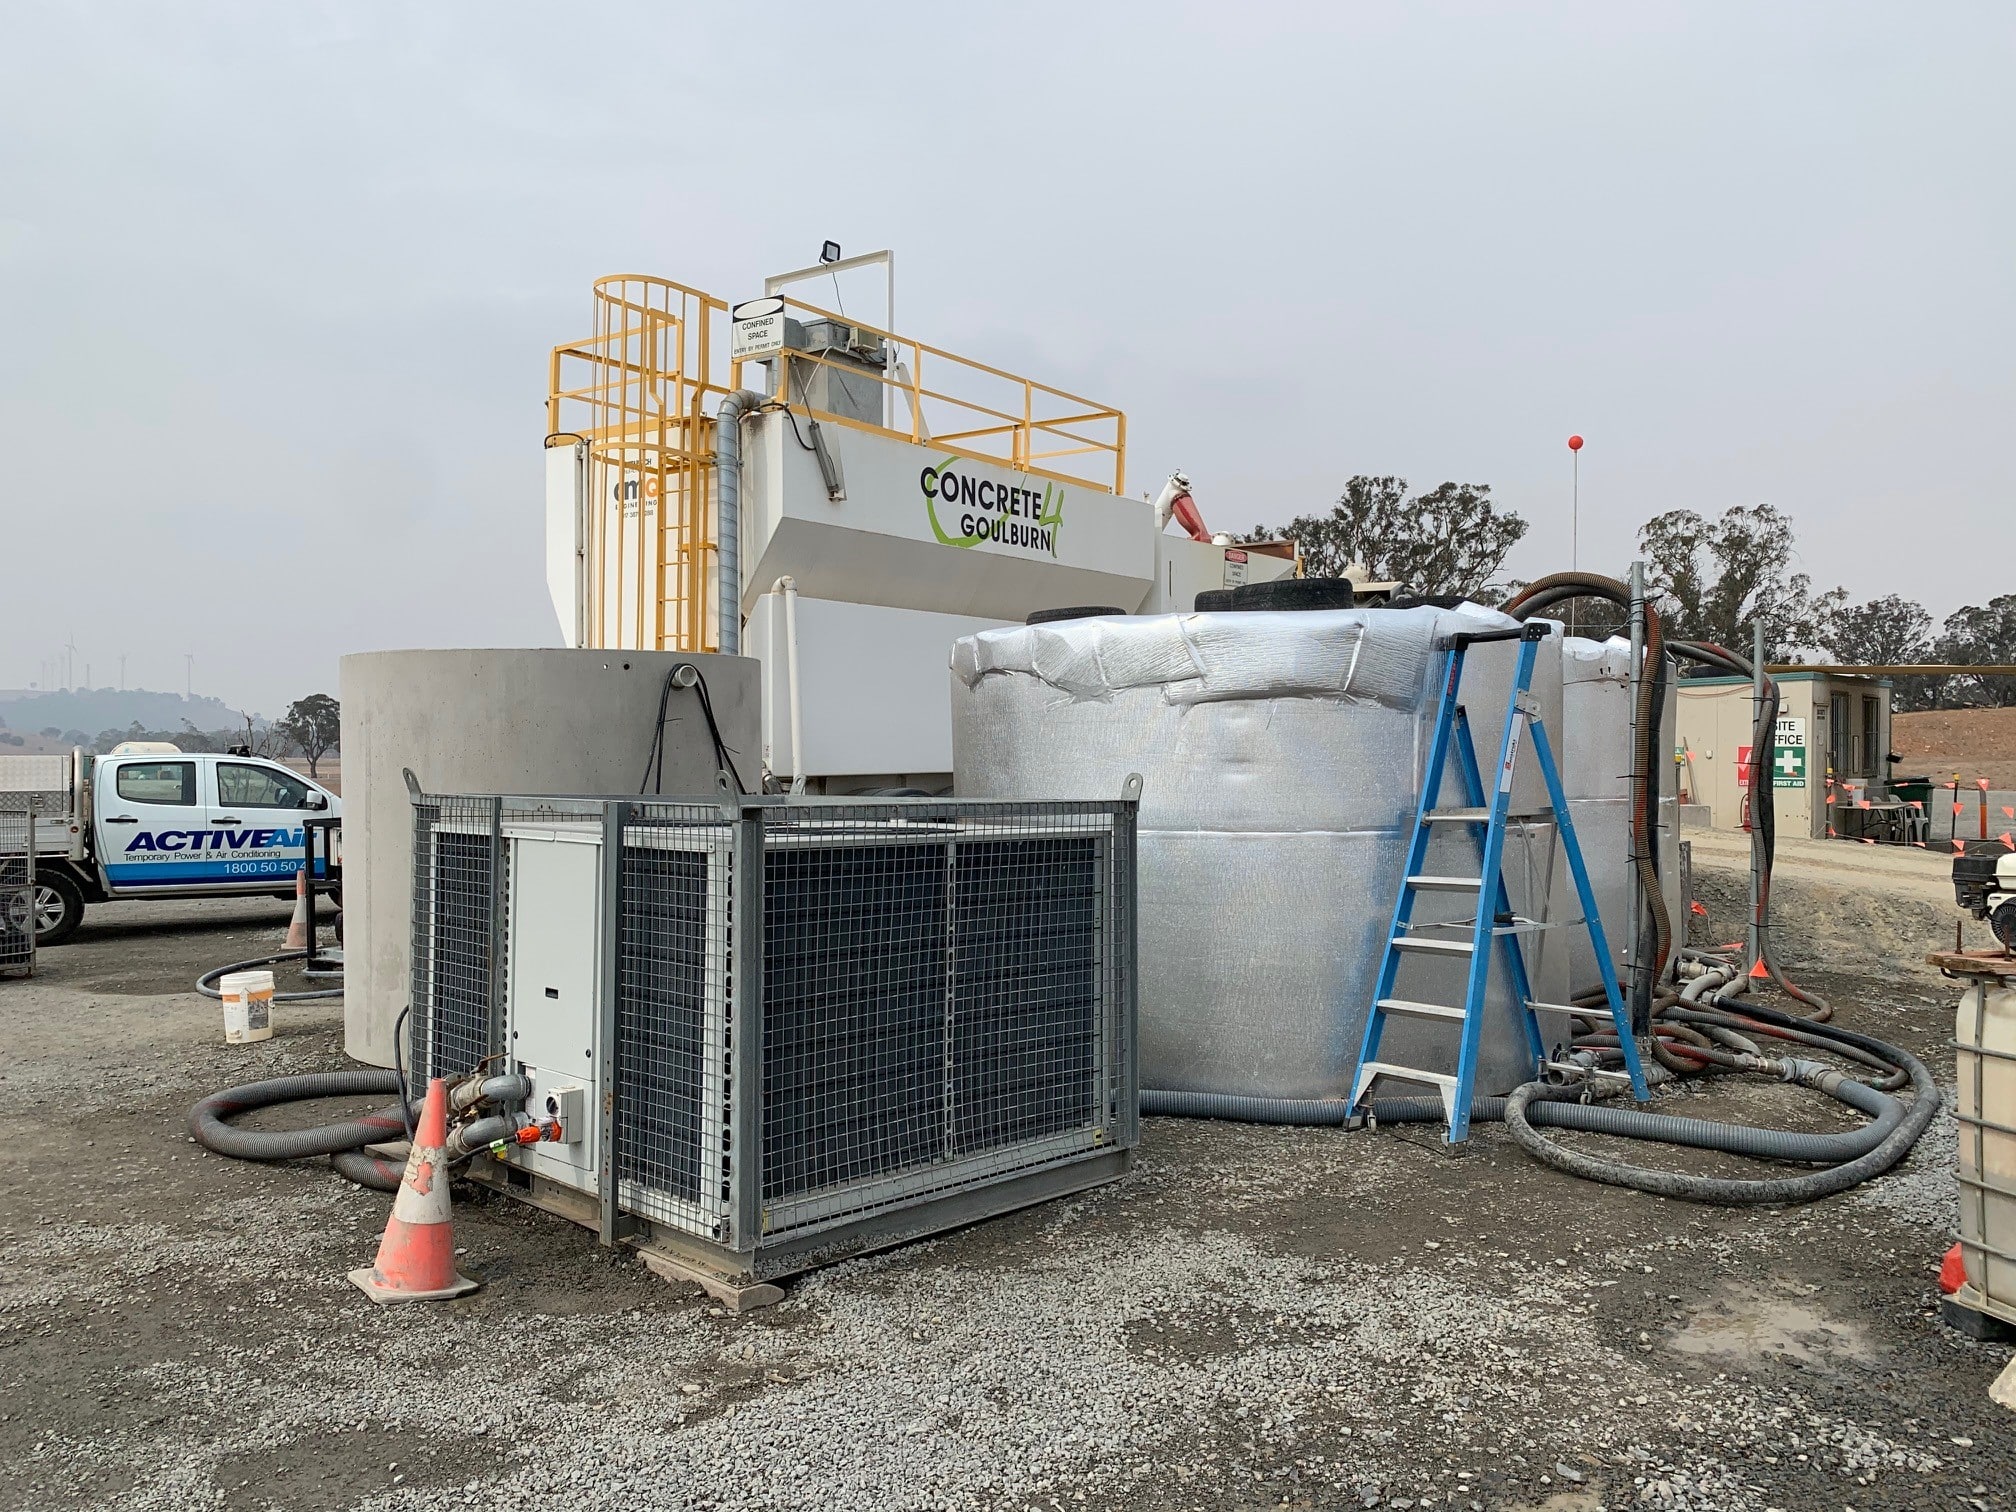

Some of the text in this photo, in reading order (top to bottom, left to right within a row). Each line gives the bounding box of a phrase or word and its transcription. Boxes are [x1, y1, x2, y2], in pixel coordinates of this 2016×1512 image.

[742, 318, 774, 330] CONFINED
[748, 330, 768, 340] SPACE
[755, 342, 770, 350] PERMIT
[920, 466, 1064, 558] CONCRETE 4
[961, 513, 1051, 551] GOULBURN
[1774, 734, 1803, 745] FICE
[123, 849, 281, 862] Temporary Power & Air Conditioning
[224, 862, 257, 874] 1800
[260, 862, 277, 873] 50
[280, 861, 297, 872] 50
